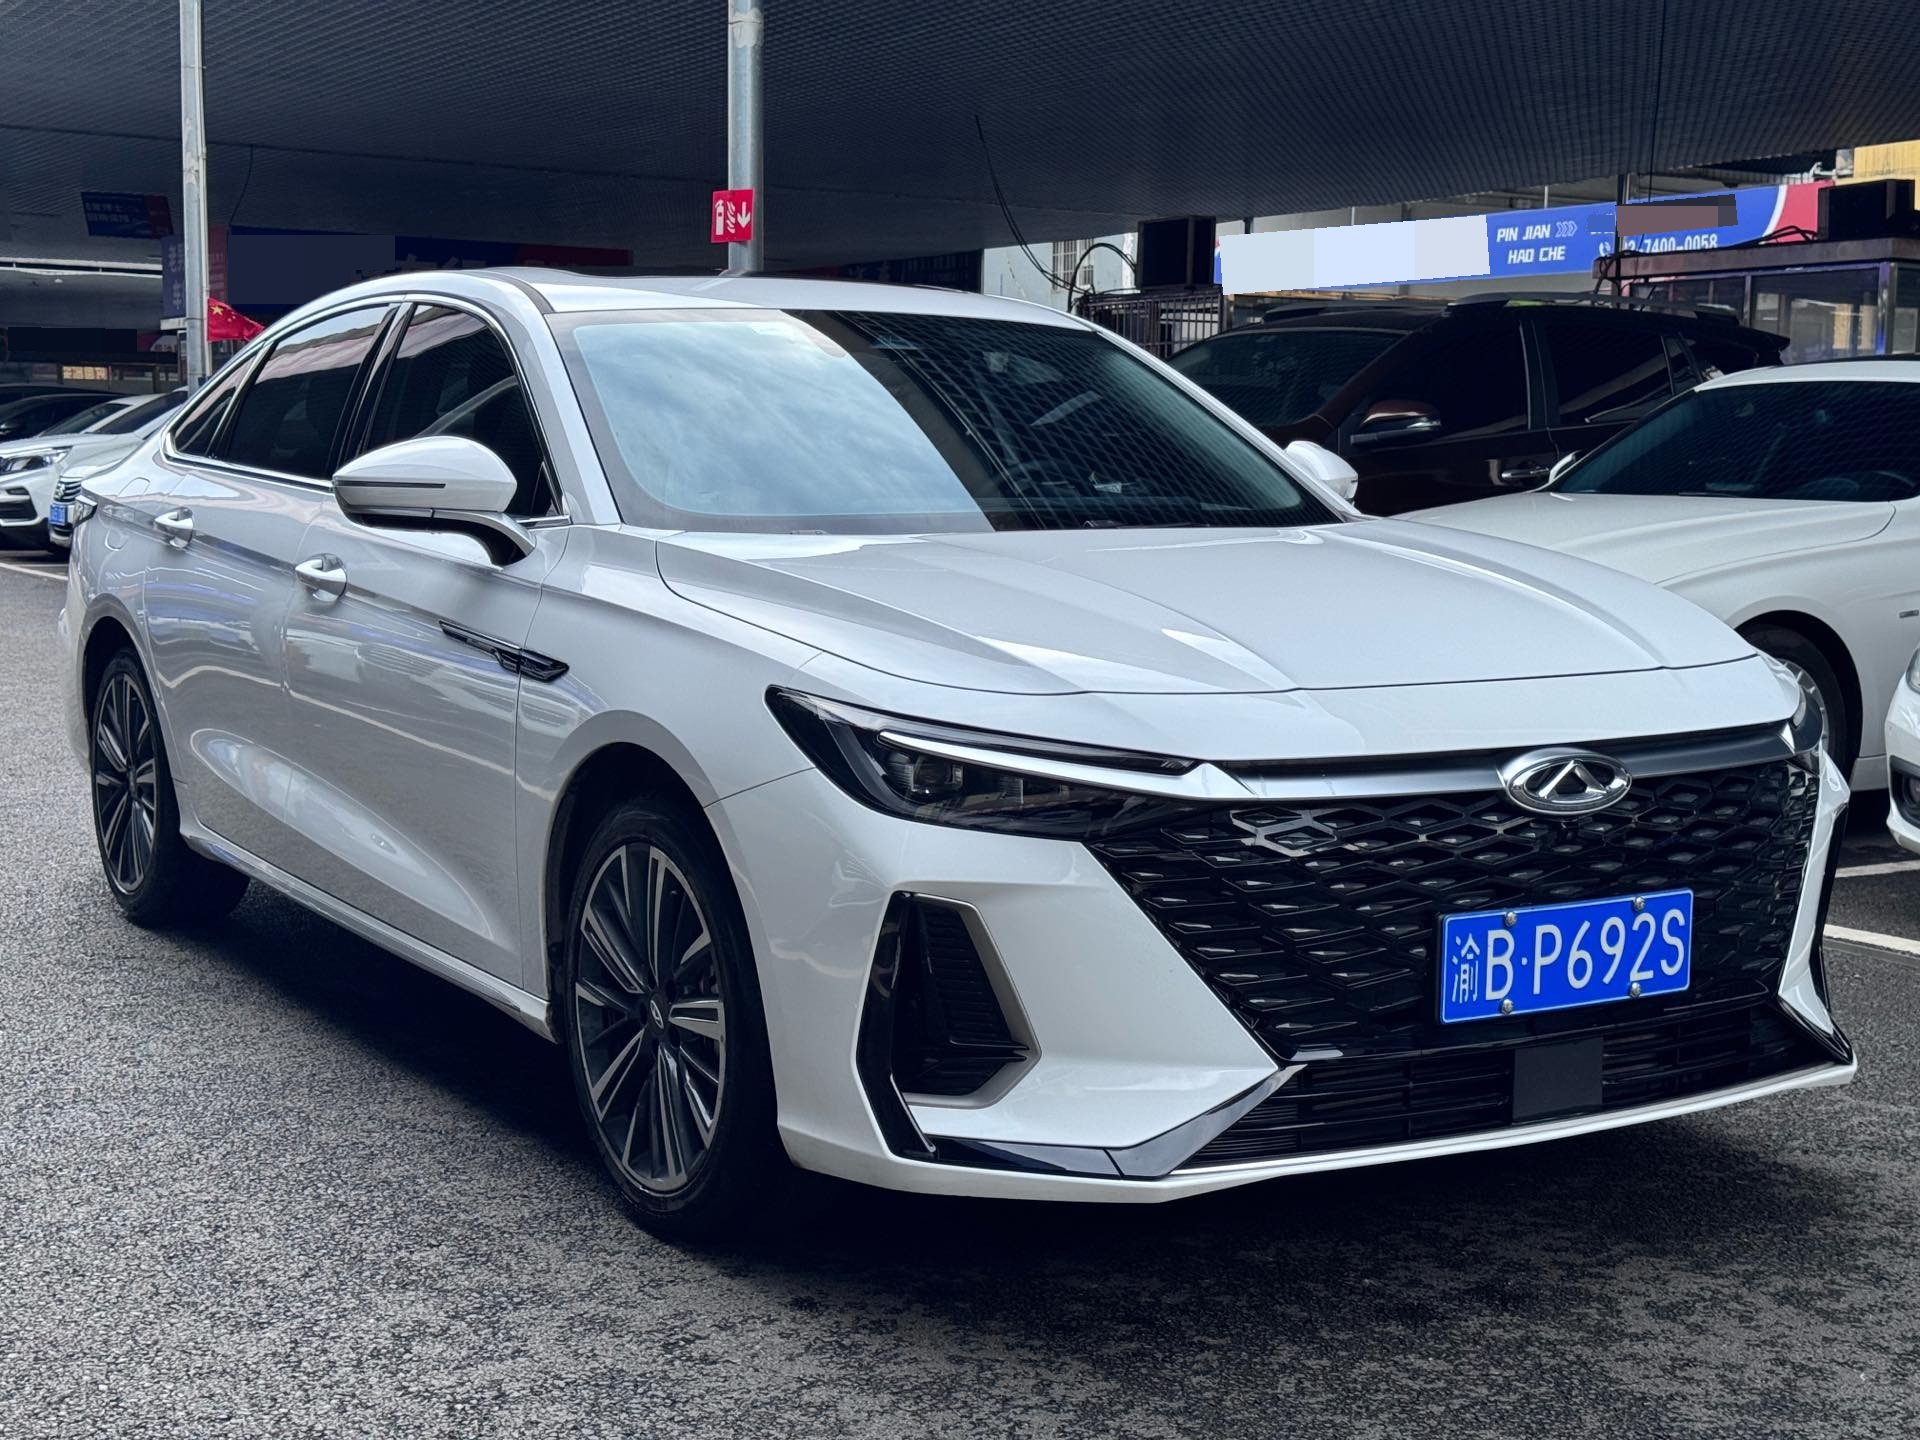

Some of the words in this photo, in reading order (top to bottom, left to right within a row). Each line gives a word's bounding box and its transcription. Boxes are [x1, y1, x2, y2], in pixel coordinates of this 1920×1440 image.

[1497, 226, 1518, 242] PIN
[1522, 225, 1550, 241] JIAN
[1508, 249, 1533, 264] HAO
[1539, 245, 1566, 262] CHE
